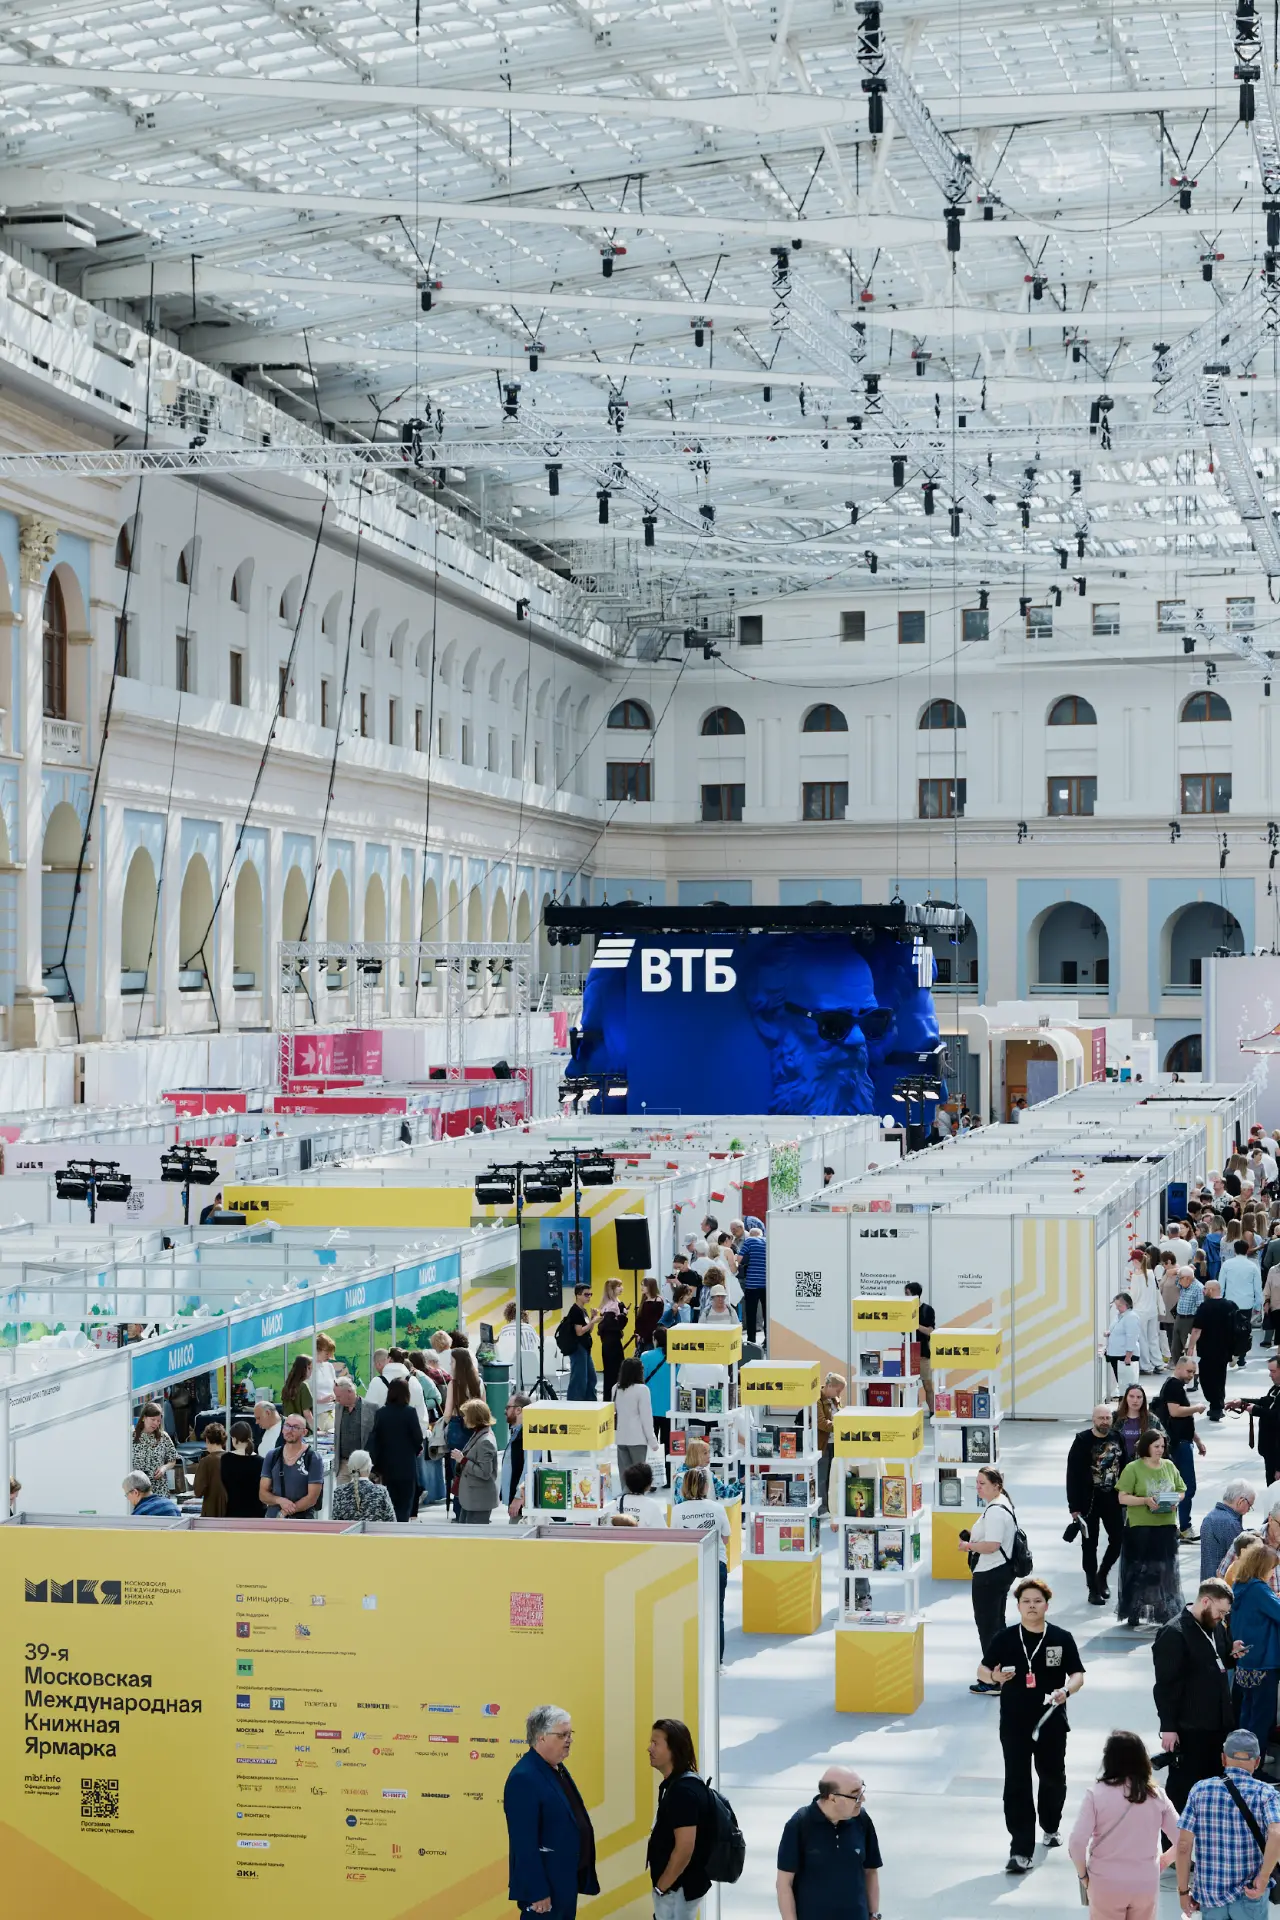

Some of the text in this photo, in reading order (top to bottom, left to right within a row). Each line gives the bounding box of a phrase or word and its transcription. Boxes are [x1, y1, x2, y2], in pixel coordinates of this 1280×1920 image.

[641, 948, 737, 992] ВТБ
[528, 1423, 568, 1434] ММКЯ
[840, 1431, 881, 1442] ММКЯ
[25, 1577, 122, 1605] ММКЯ
[24, 1642, 69, 1661] 39-я
[24, 1666, 153, 1688] Московская
[24, 1689, 203, 1715] Международная
[24, 1712, 120, 1734] Книжная
[24, 1736, 117, 1760] Ярмарка
[24, 1774, 62, 1783] mibf.info
